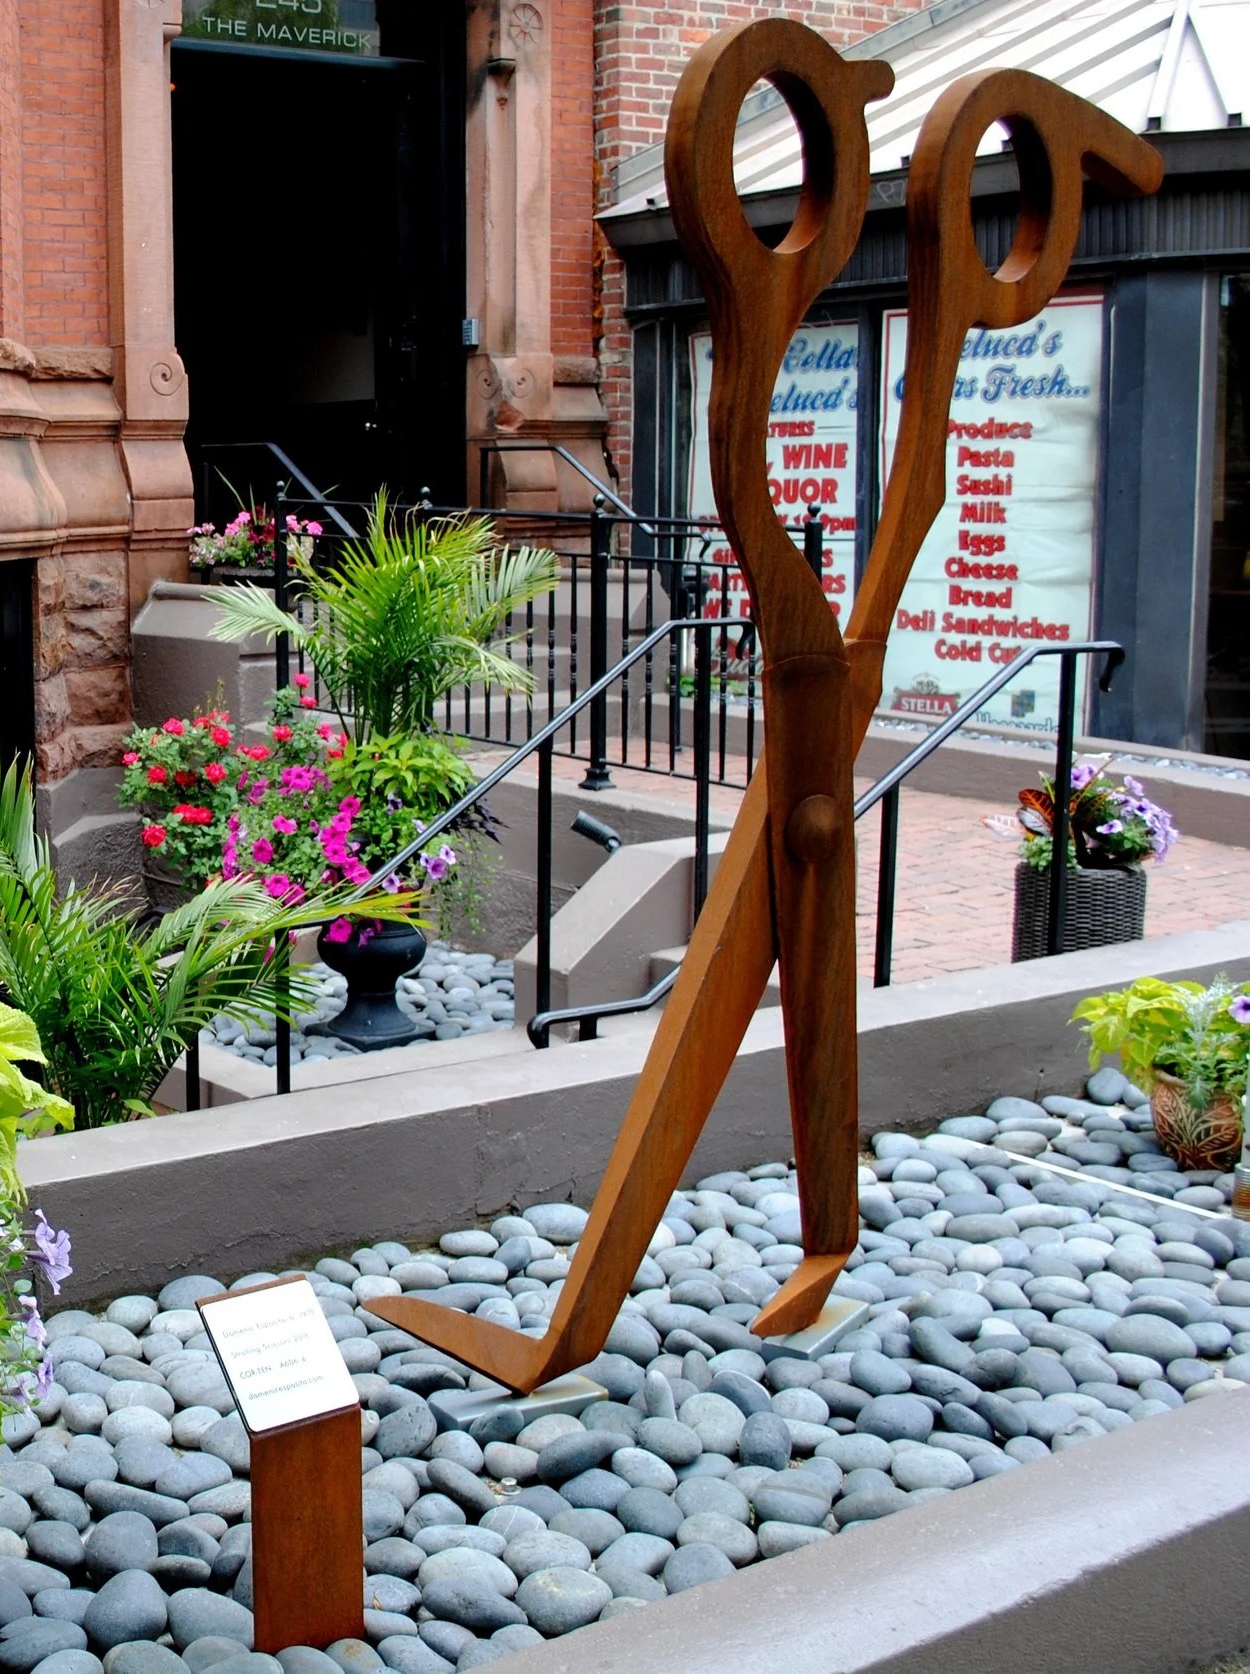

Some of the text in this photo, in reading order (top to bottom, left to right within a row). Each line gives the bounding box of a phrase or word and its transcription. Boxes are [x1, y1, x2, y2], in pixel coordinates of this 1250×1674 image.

[203, 17, 371, 49] THE MAVERICK
[961, 319, 1062, 361] eluca's
[784, 336, 857, 373] Cella
[770, 376, 858, 414] eluca's
[947, 417, 1033, 440] Produce
[782, 443, 849, 469] WINE
[957, 446, 1015, 467] Pasta
[768, 477, 838, 505] QUOR
[956, 473, 1013, 496] Sushi
[959, 501, 1007, 523] Milk
[958, 530, 1006, 557] Eggs
[945, 557, 1019, 580] Cheese
[948, 585, 1013, 609] Bread
[897, 608, 1070, 641] Deli Sandwiches
[934, 638, 982, 662] Cold
[901, 696, 953, 715] STELLA
